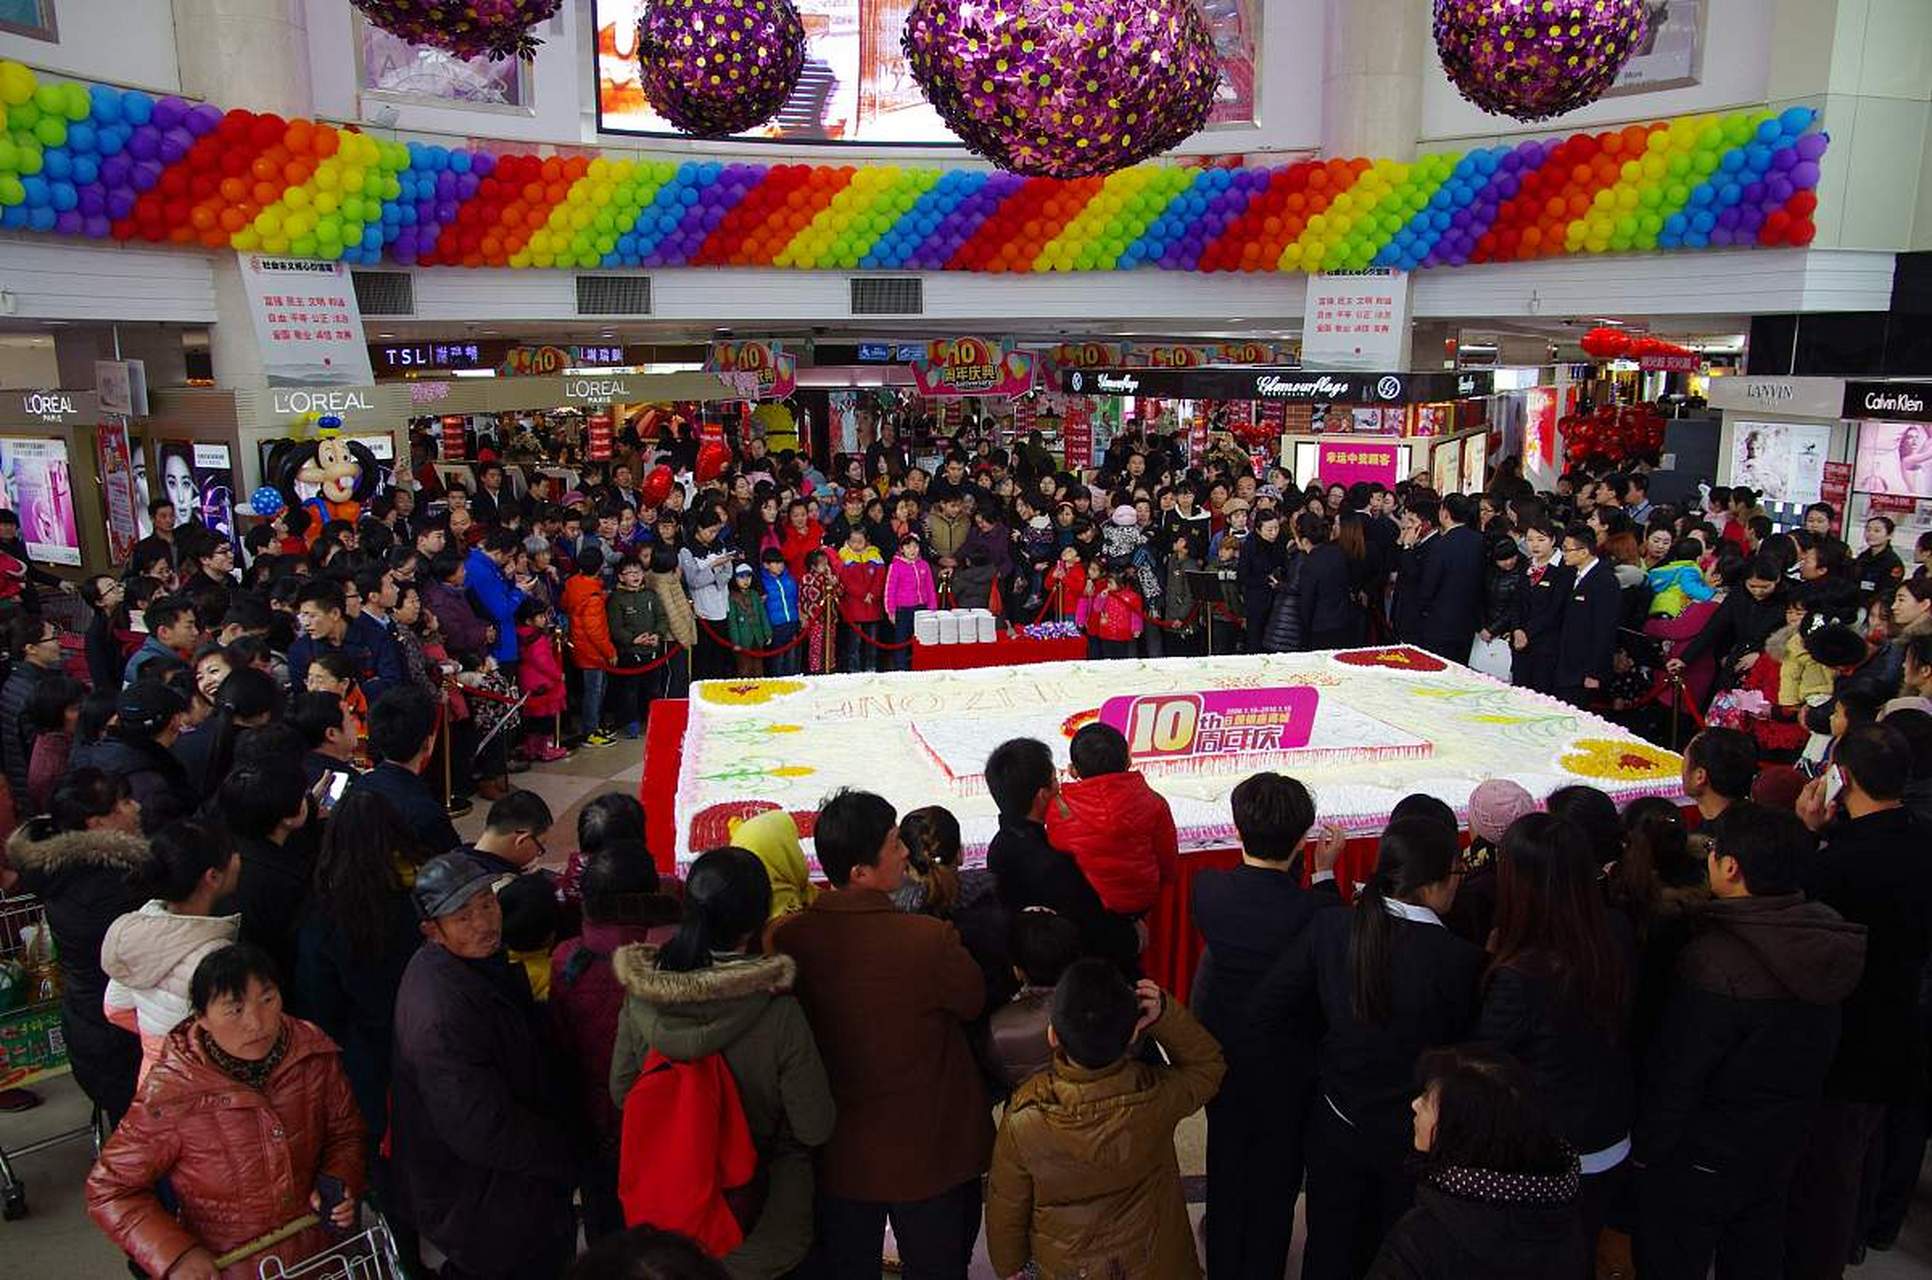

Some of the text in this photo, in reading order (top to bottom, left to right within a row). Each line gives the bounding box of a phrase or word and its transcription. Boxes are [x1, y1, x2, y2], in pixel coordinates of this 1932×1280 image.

[385, 348, 426, 365] TSL
[947, 342, 976, 366] 10
[587, 396, 612, 404] PARIS
[1748, 383, 1793, 400] LANVIN
[1865, 391, 1924, 412] Calvin Klein
[1132, 700, 1222, 752] 10 th
